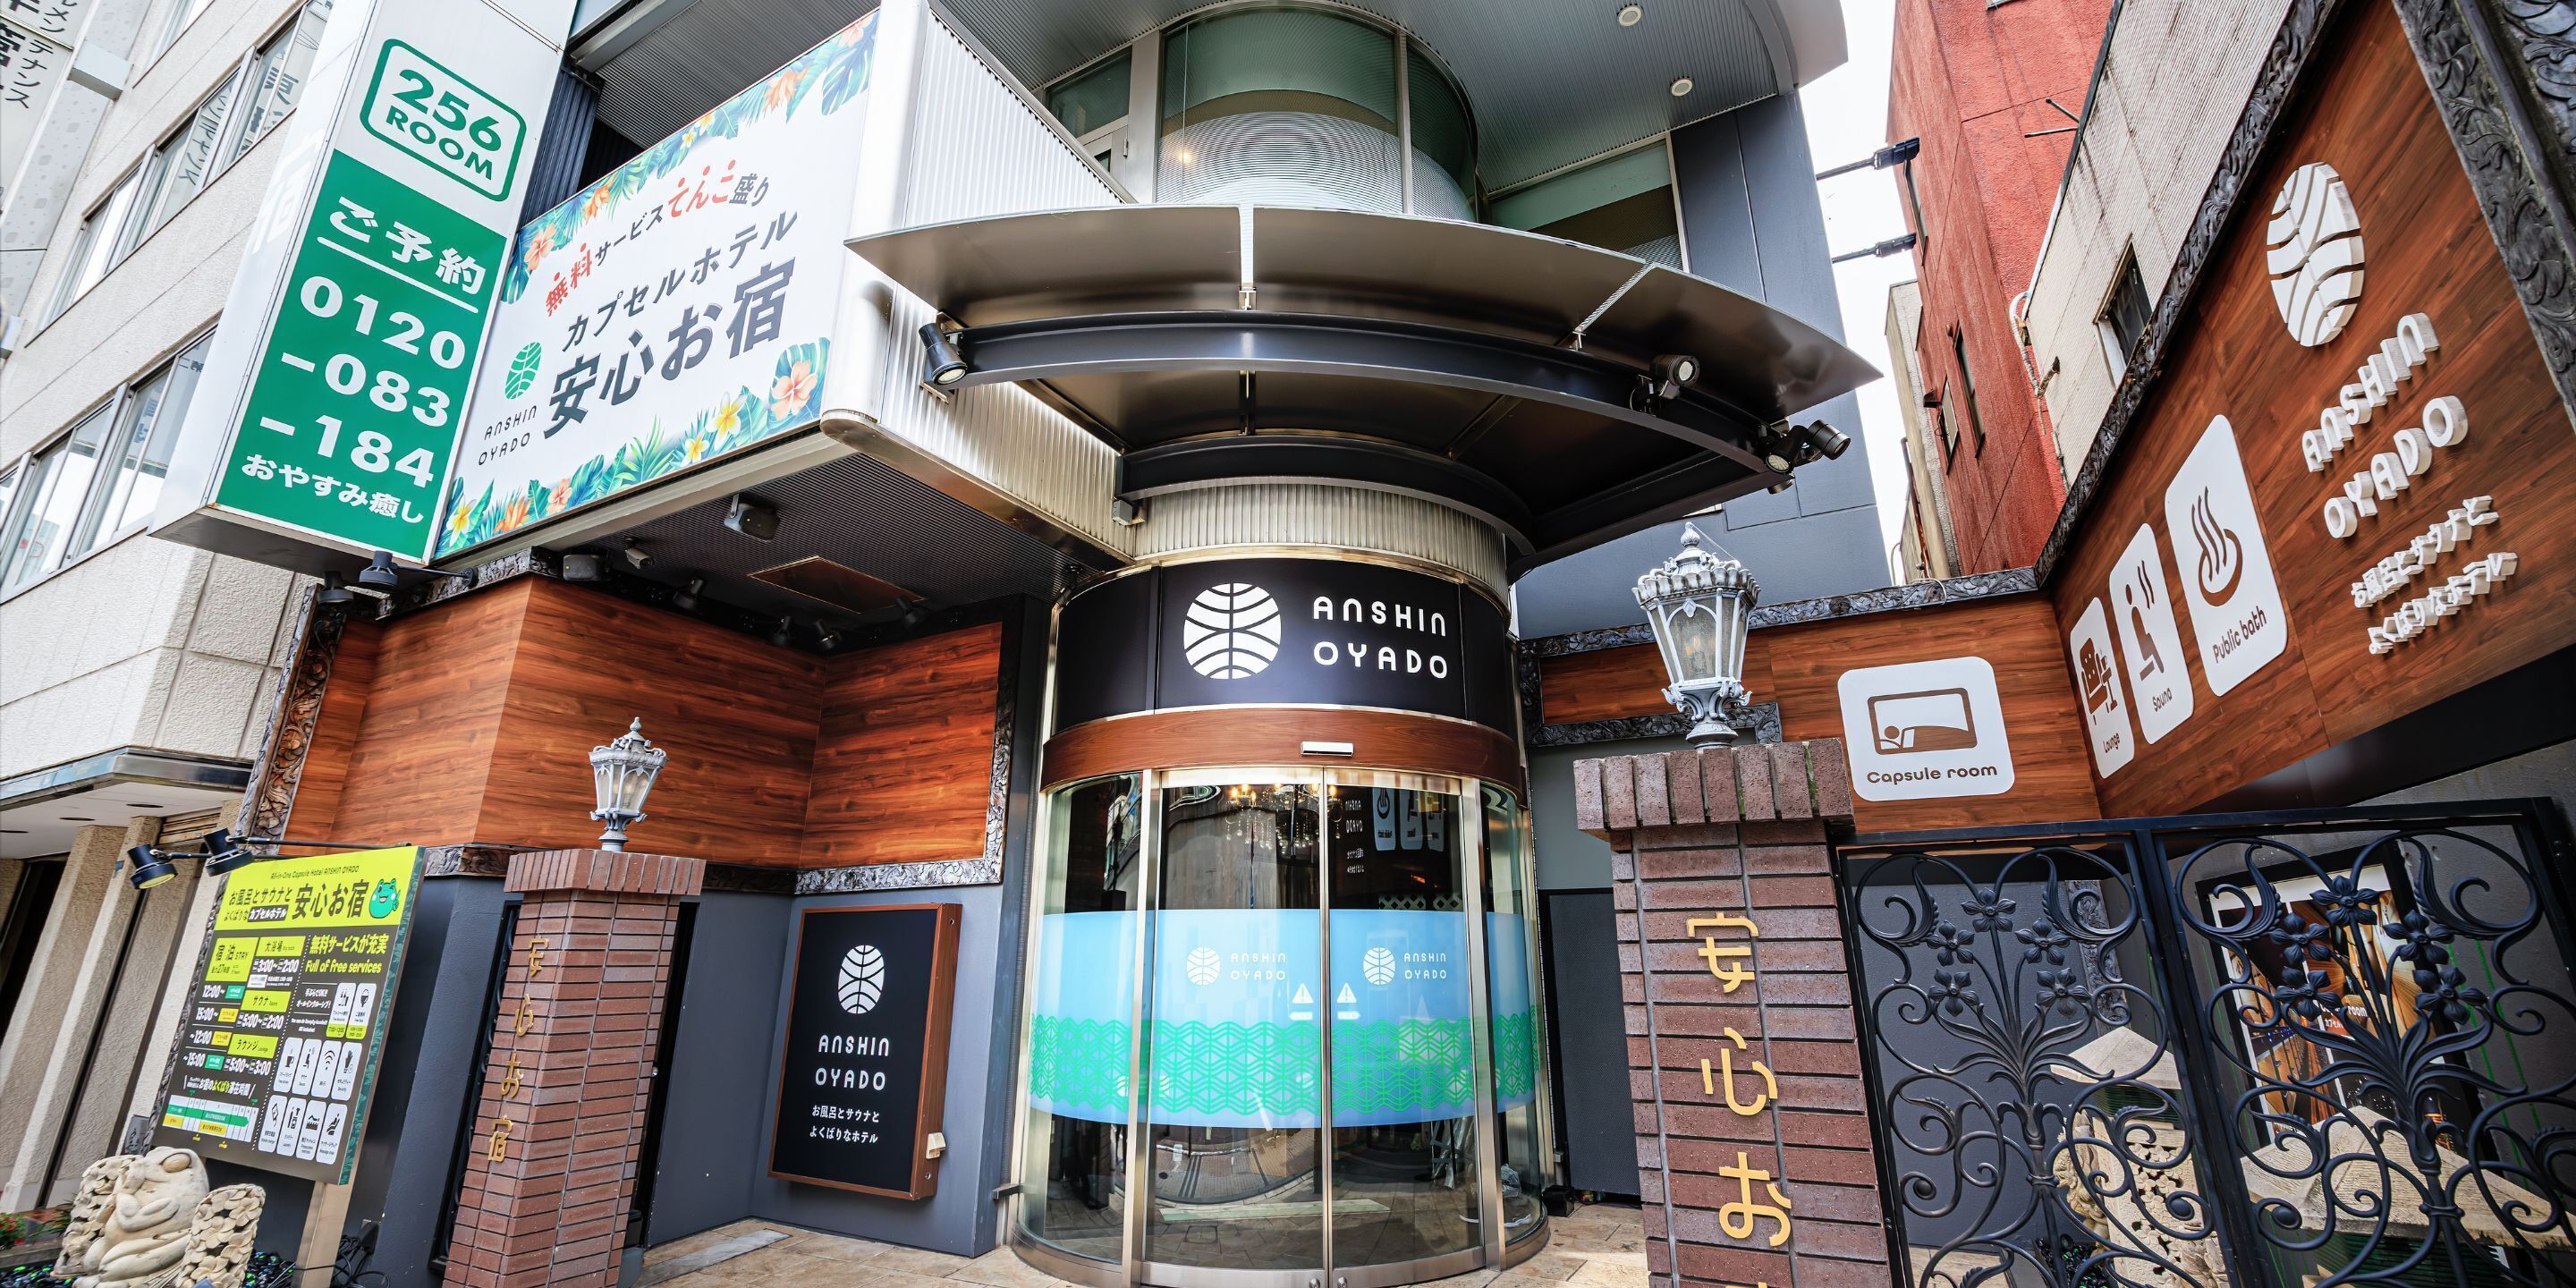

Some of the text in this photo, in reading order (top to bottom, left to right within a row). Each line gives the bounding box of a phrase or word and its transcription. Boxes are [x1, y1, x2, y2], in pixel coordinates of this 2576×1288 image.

[391, 68, 503, 151] 256
[386, 109, 493, 181] ROOM
[330, 197, 487, 296] ご予約
[546, 165, 770, 318] 無料サービスてんこ盛り
[562, 210, 798, 352] カプセルホテル
[300, 275, 466, 369] 0120
[544, 257, 796, 439] 安心お宿
[281, 352, 451, 428] -083
[2302, 312, 2440, 472] ANSHIN
[484, 405, 537, 440] ANSHIN
[259, 414, 435, 488] -184
[479, 432, 530, 466] OYADO
[2325, 394, 2469, 538] OYADO
[242, 453, 424, 523] おやすみ癒し
[2351, 495, 2500, 609] お風呂とサウナと
[1312, 596, 1446, 637] ANSHIN
[2213, 606, 2267, 664] Public bath
[1313, 640, 1448, 679] OYADO
[2152, 686, 2173, 713] Sauna
[2103, 732, 2121, 754] Lounge
[1867, 766, 1997, 785] Capsule room
[229, 886, 293, 906] お風呂とサウナと
[249, 907, 287, 920] カプセルホテル
[292, 879, 369, 920] 安心お宿
[309, 933, 389, 955] 無料サービスが充実
[1231, 953, 1286, 963] ANSHIN
[1403, 953, 1446, 962] ANSHIN
[305, 959, 382, 973] Full of free services
[1231, 970, 1286, 980] OYADO
[1404, 970, 1447, 979] OYADO
[488, 935, 548, 1163] 安心お宿
[818, 1035, 889, 1056] ANSHIN
[815, 1067, 886, 1091] OYADO
[812, 1105, 880, 1123] お風呂とサウナと
[1686, 912, 1792, 1288] 安心お
[809, 1125, 878, 1144] よくばりなホテル
